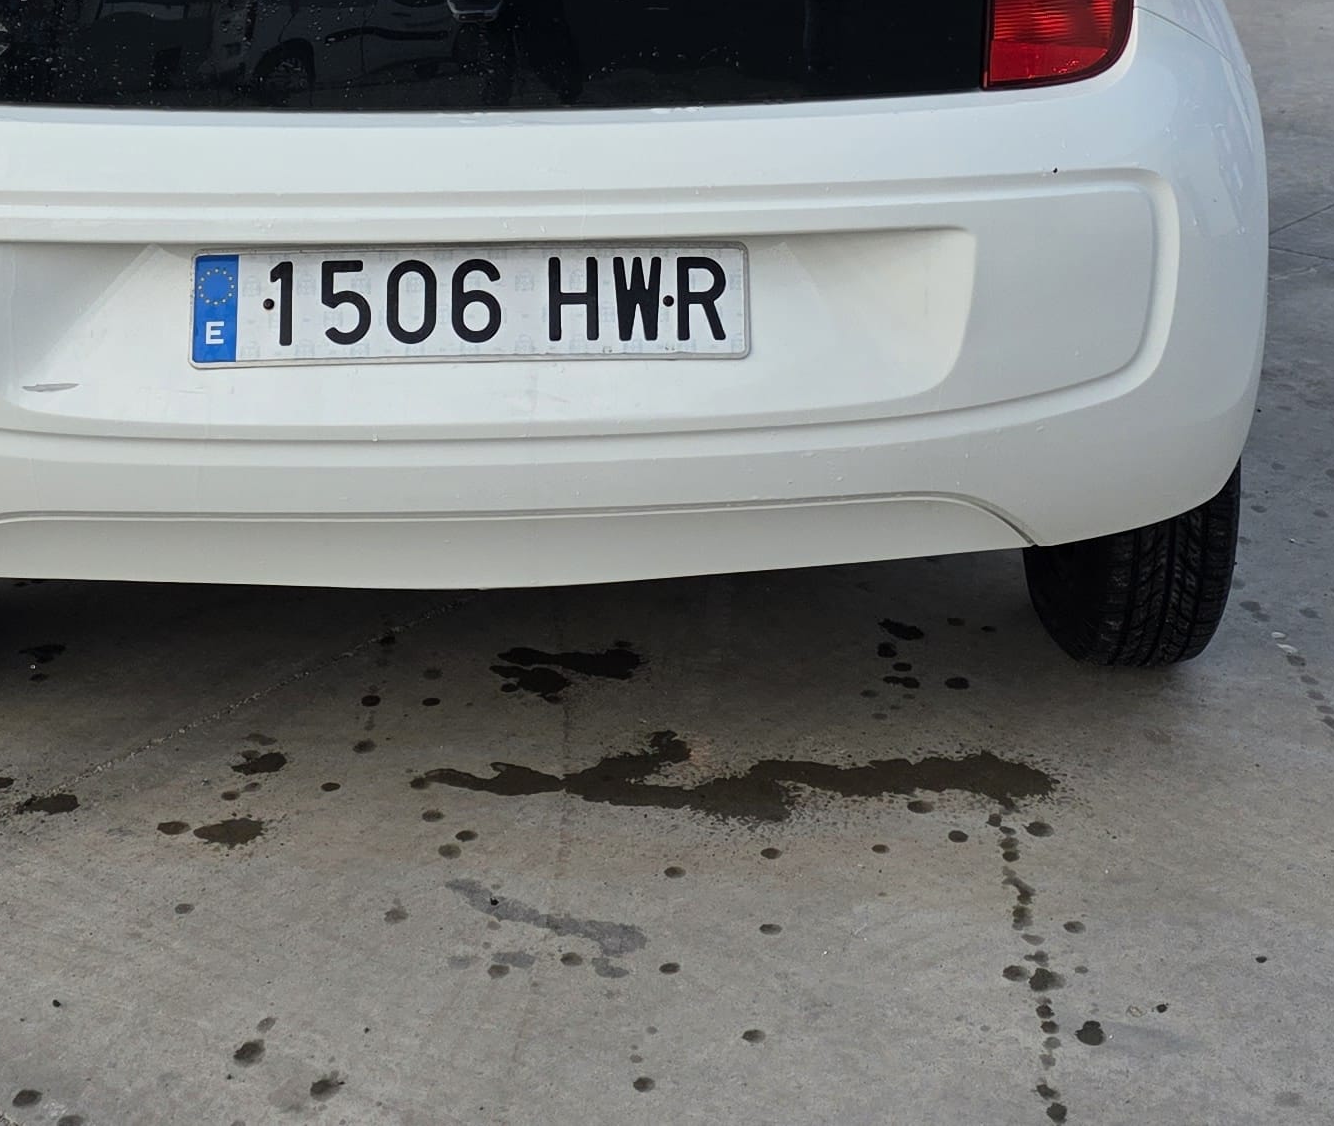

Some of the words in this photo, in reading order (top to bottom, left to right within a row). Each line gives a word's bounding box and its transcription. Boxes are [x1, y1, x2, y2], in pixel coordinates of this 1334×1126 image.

[269, 258, 502, 346] 1506
[548, 256, 727, 342] HWR
[204, 321, 224, 345] E
